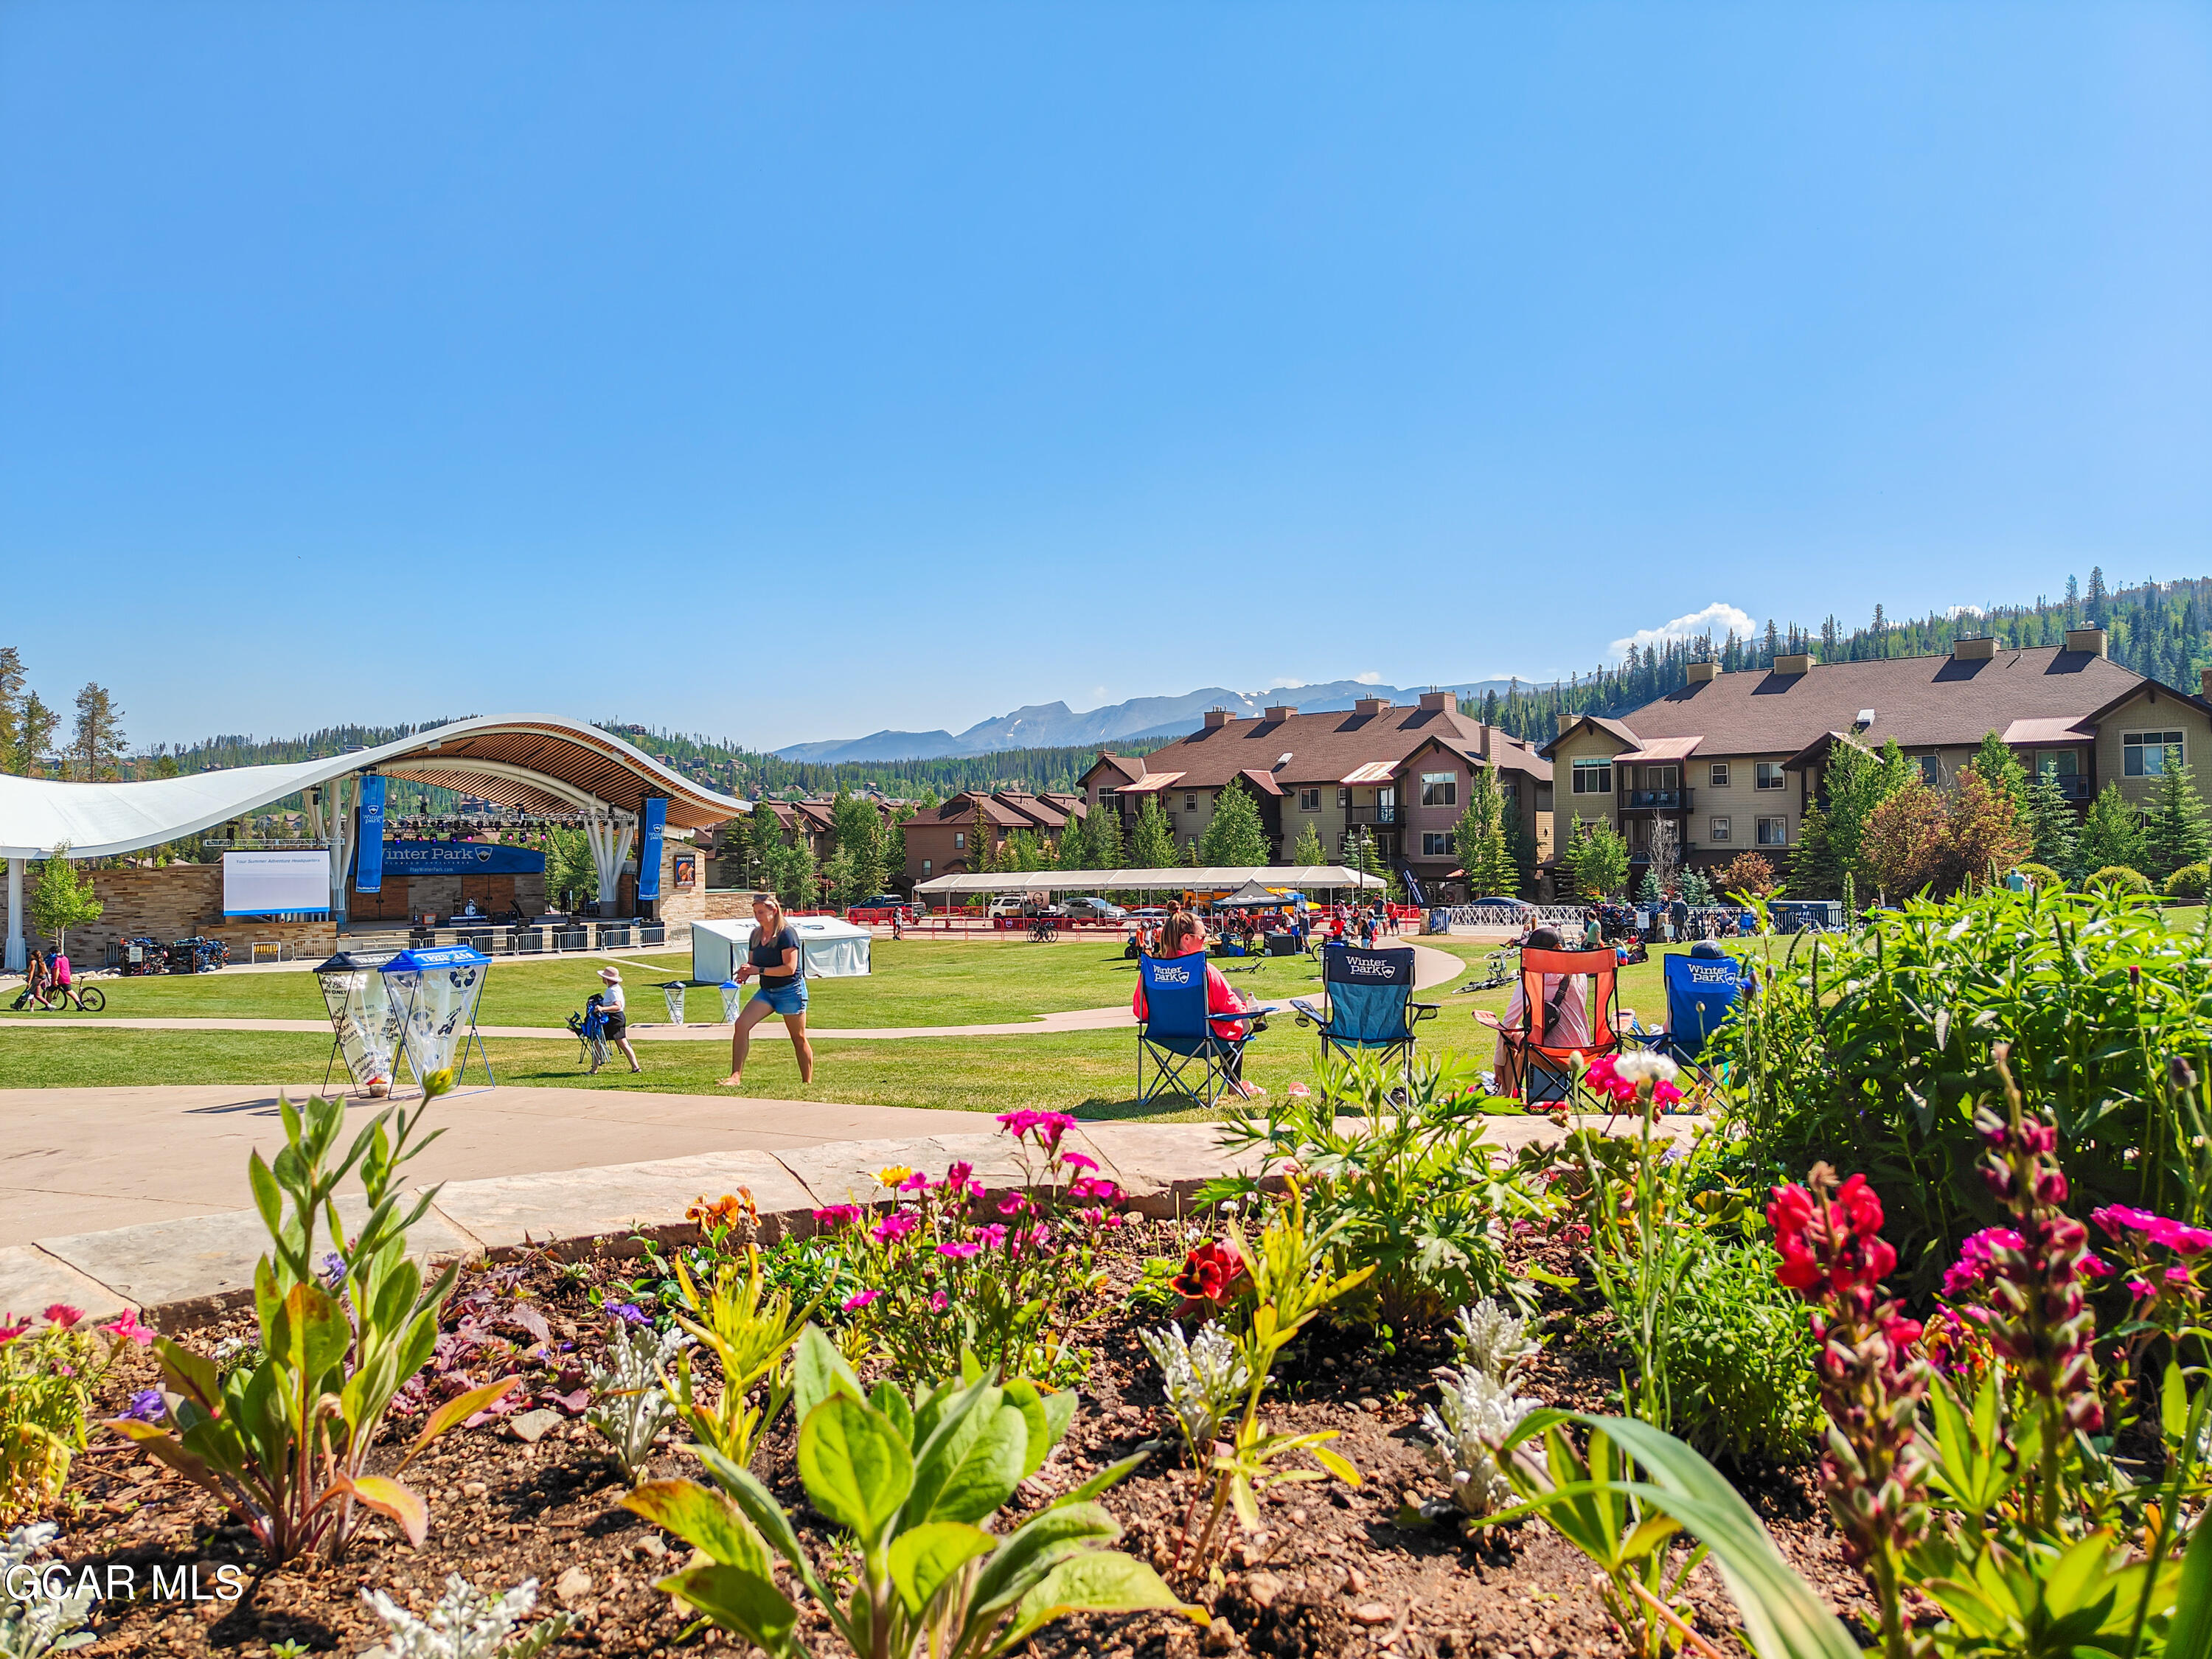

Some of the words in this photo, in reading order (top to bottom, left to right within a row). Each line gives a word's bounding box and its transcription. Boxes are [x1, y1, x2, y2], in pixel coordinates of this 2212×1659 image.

[431, 848, 474, 860] Park
[1346, 956, 1387, 967] Winter
[1152, 964, 1183, 974] Winter
[1687, 963, 1729, 974] Winter
